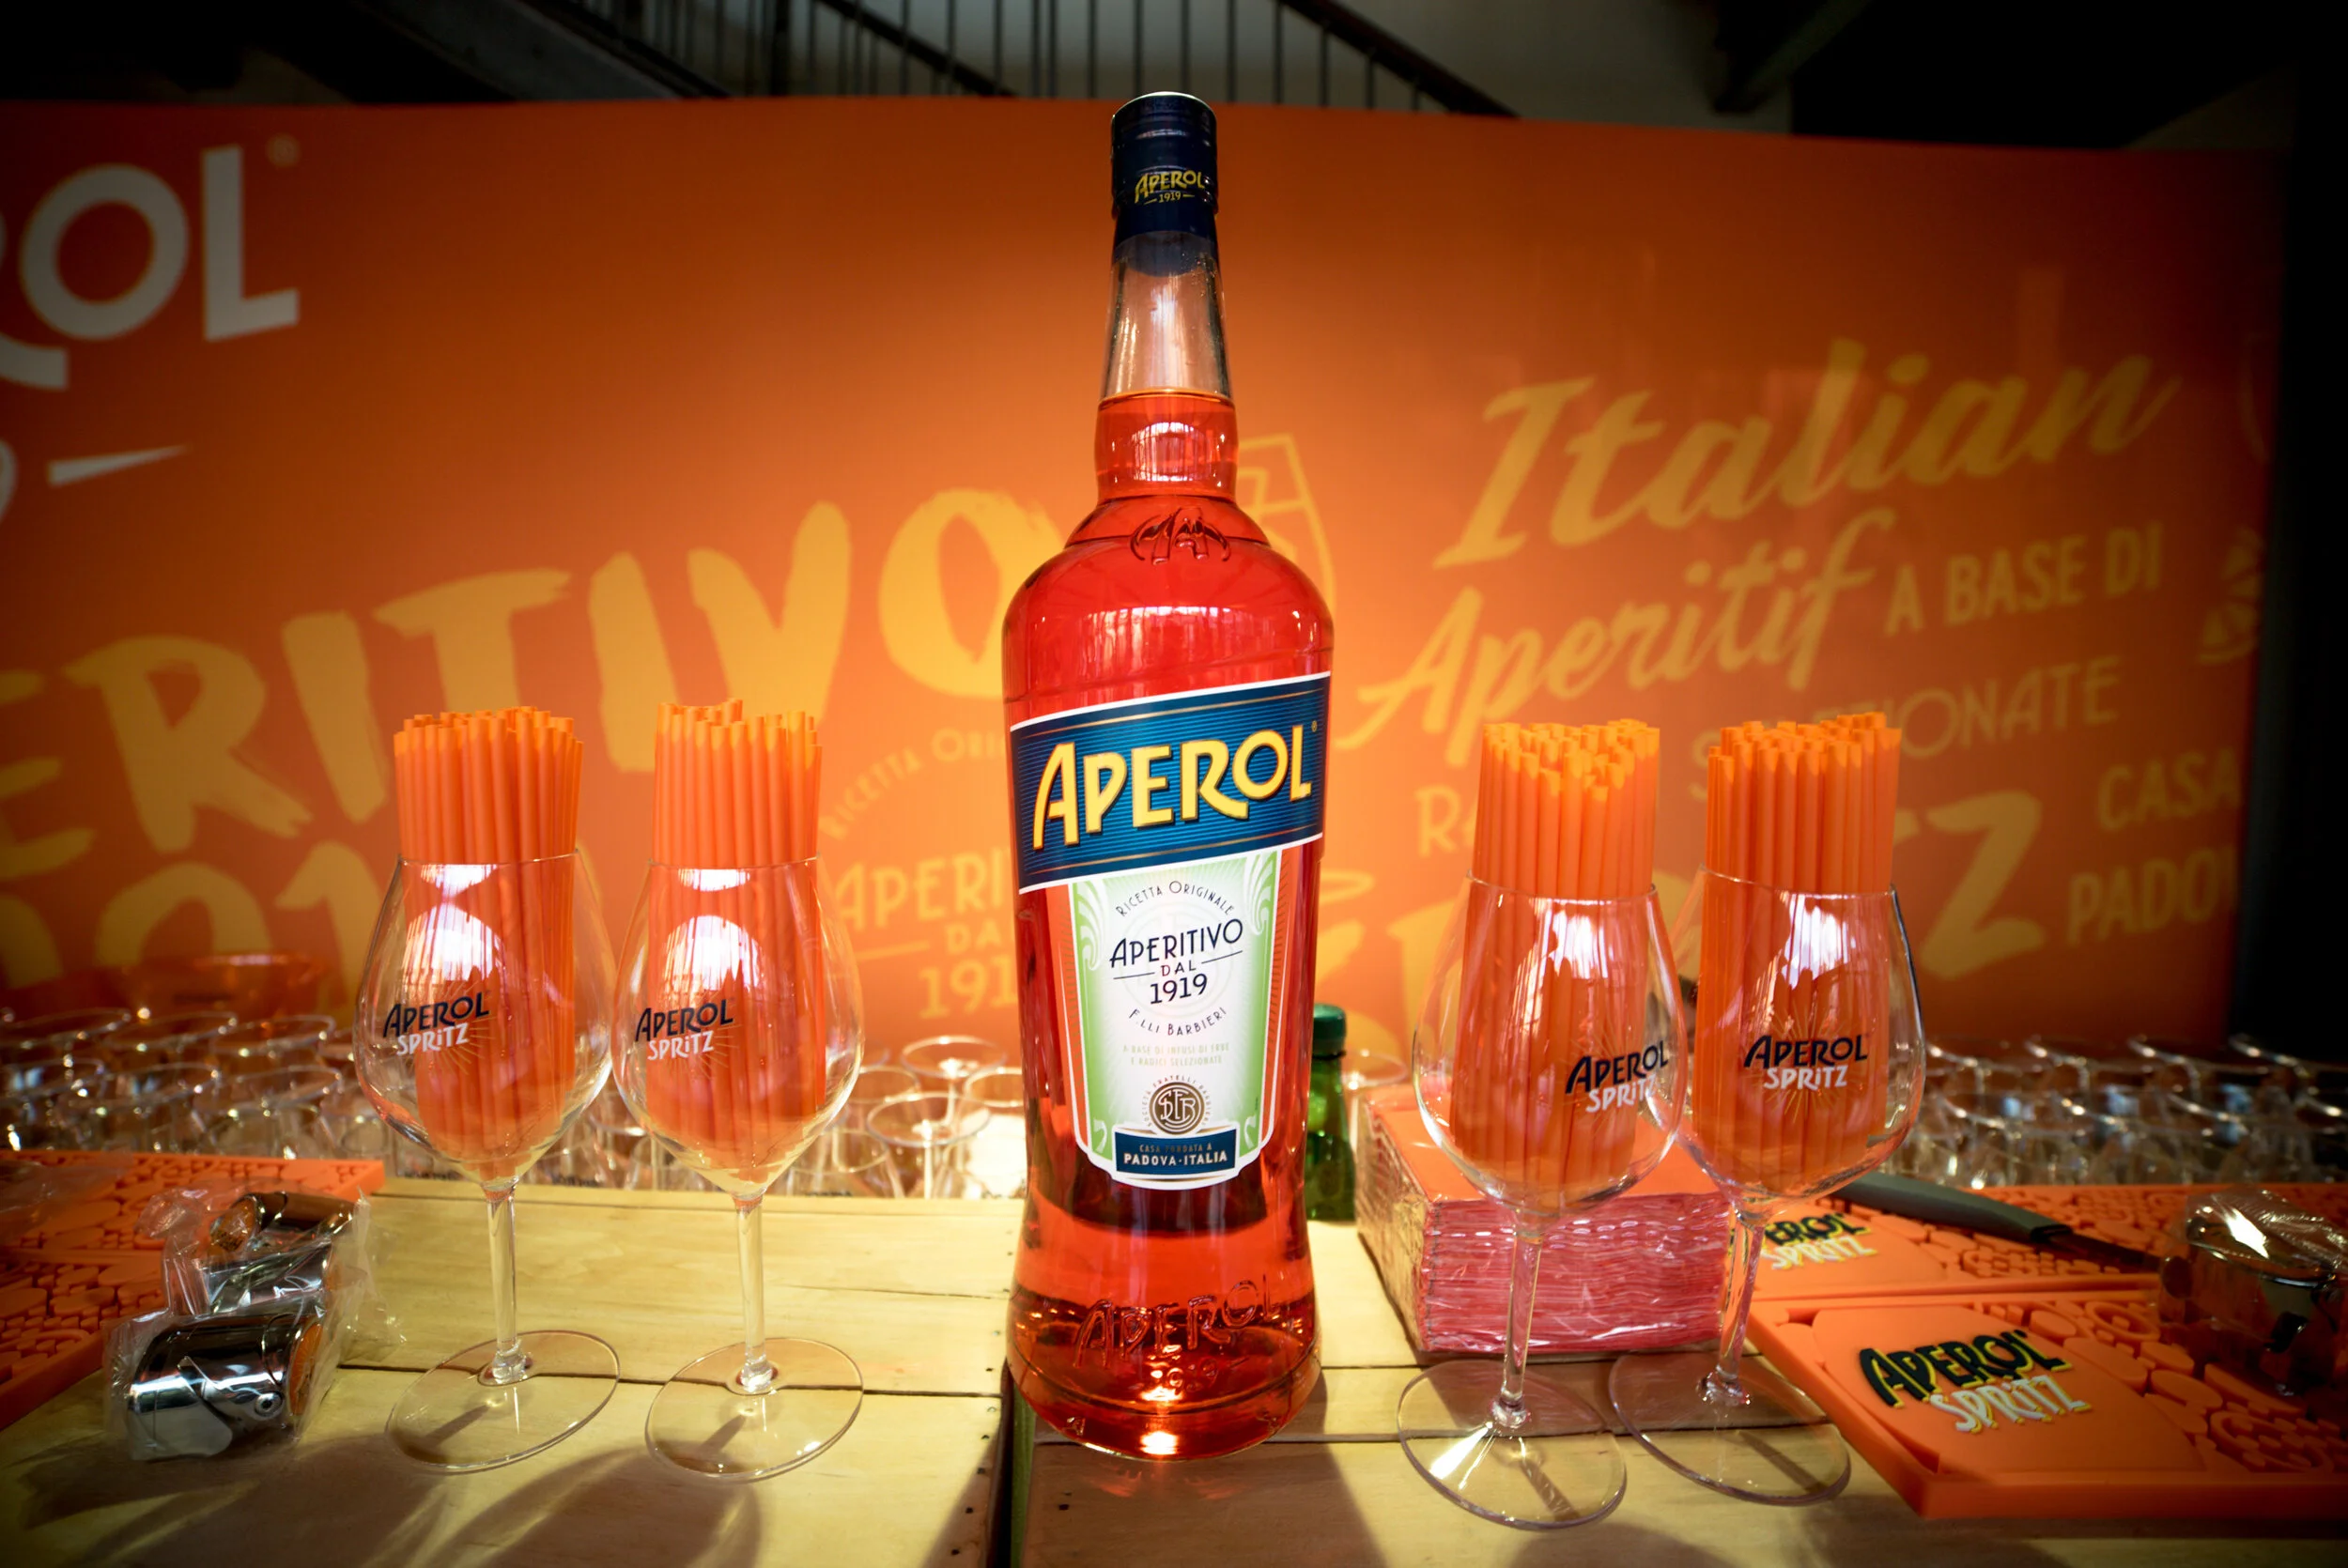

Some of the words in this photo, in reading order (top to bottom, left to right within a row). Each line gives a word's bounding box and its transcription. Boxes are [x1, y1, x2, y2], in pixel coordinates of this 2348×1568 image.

[1134, 169, 1205, 204] APEROL
[1158, 191, 1182, 204] 1919
[0, 143, 300, 391] OL
[1434, 338, 2182, 568] Italian
[1883, 562, 1924, 638] A
[1944, 534, 2087, 627] BASE
[2105, 521, 2163, 599] DI
[1333, 509, 1894, 768] Aperitif
[1033, 725, 1312, 851] APEROL
[2099, 747, 2242, 832] CASA
[1116, 884, 1164, 917] RICETTA
[1168, 880, 1235, 916] ORIGINALE
[1109, 918, 1244, 968] APERITIVO
[918, 954, 1018, 1020] 191
[1150, 973, 1209, 1005] 1919
[1161, 959, 1197, 977] DAL
[383, 992, 489, 1038] APEROL
[635, 998, 734, 1042] APEROL
[1167, 1007, 1227, 1036] BARBIERI
[1565, 1039, 1669, 1095] APEROL
[1743, 1035, 1868, 1069] APEROL
[1123, 1152, 1177, 1166] PADOVA
[1183, 1150, 1228, 1165] ITALIA
[1860, 1330, 2073, 1408] APEROL
